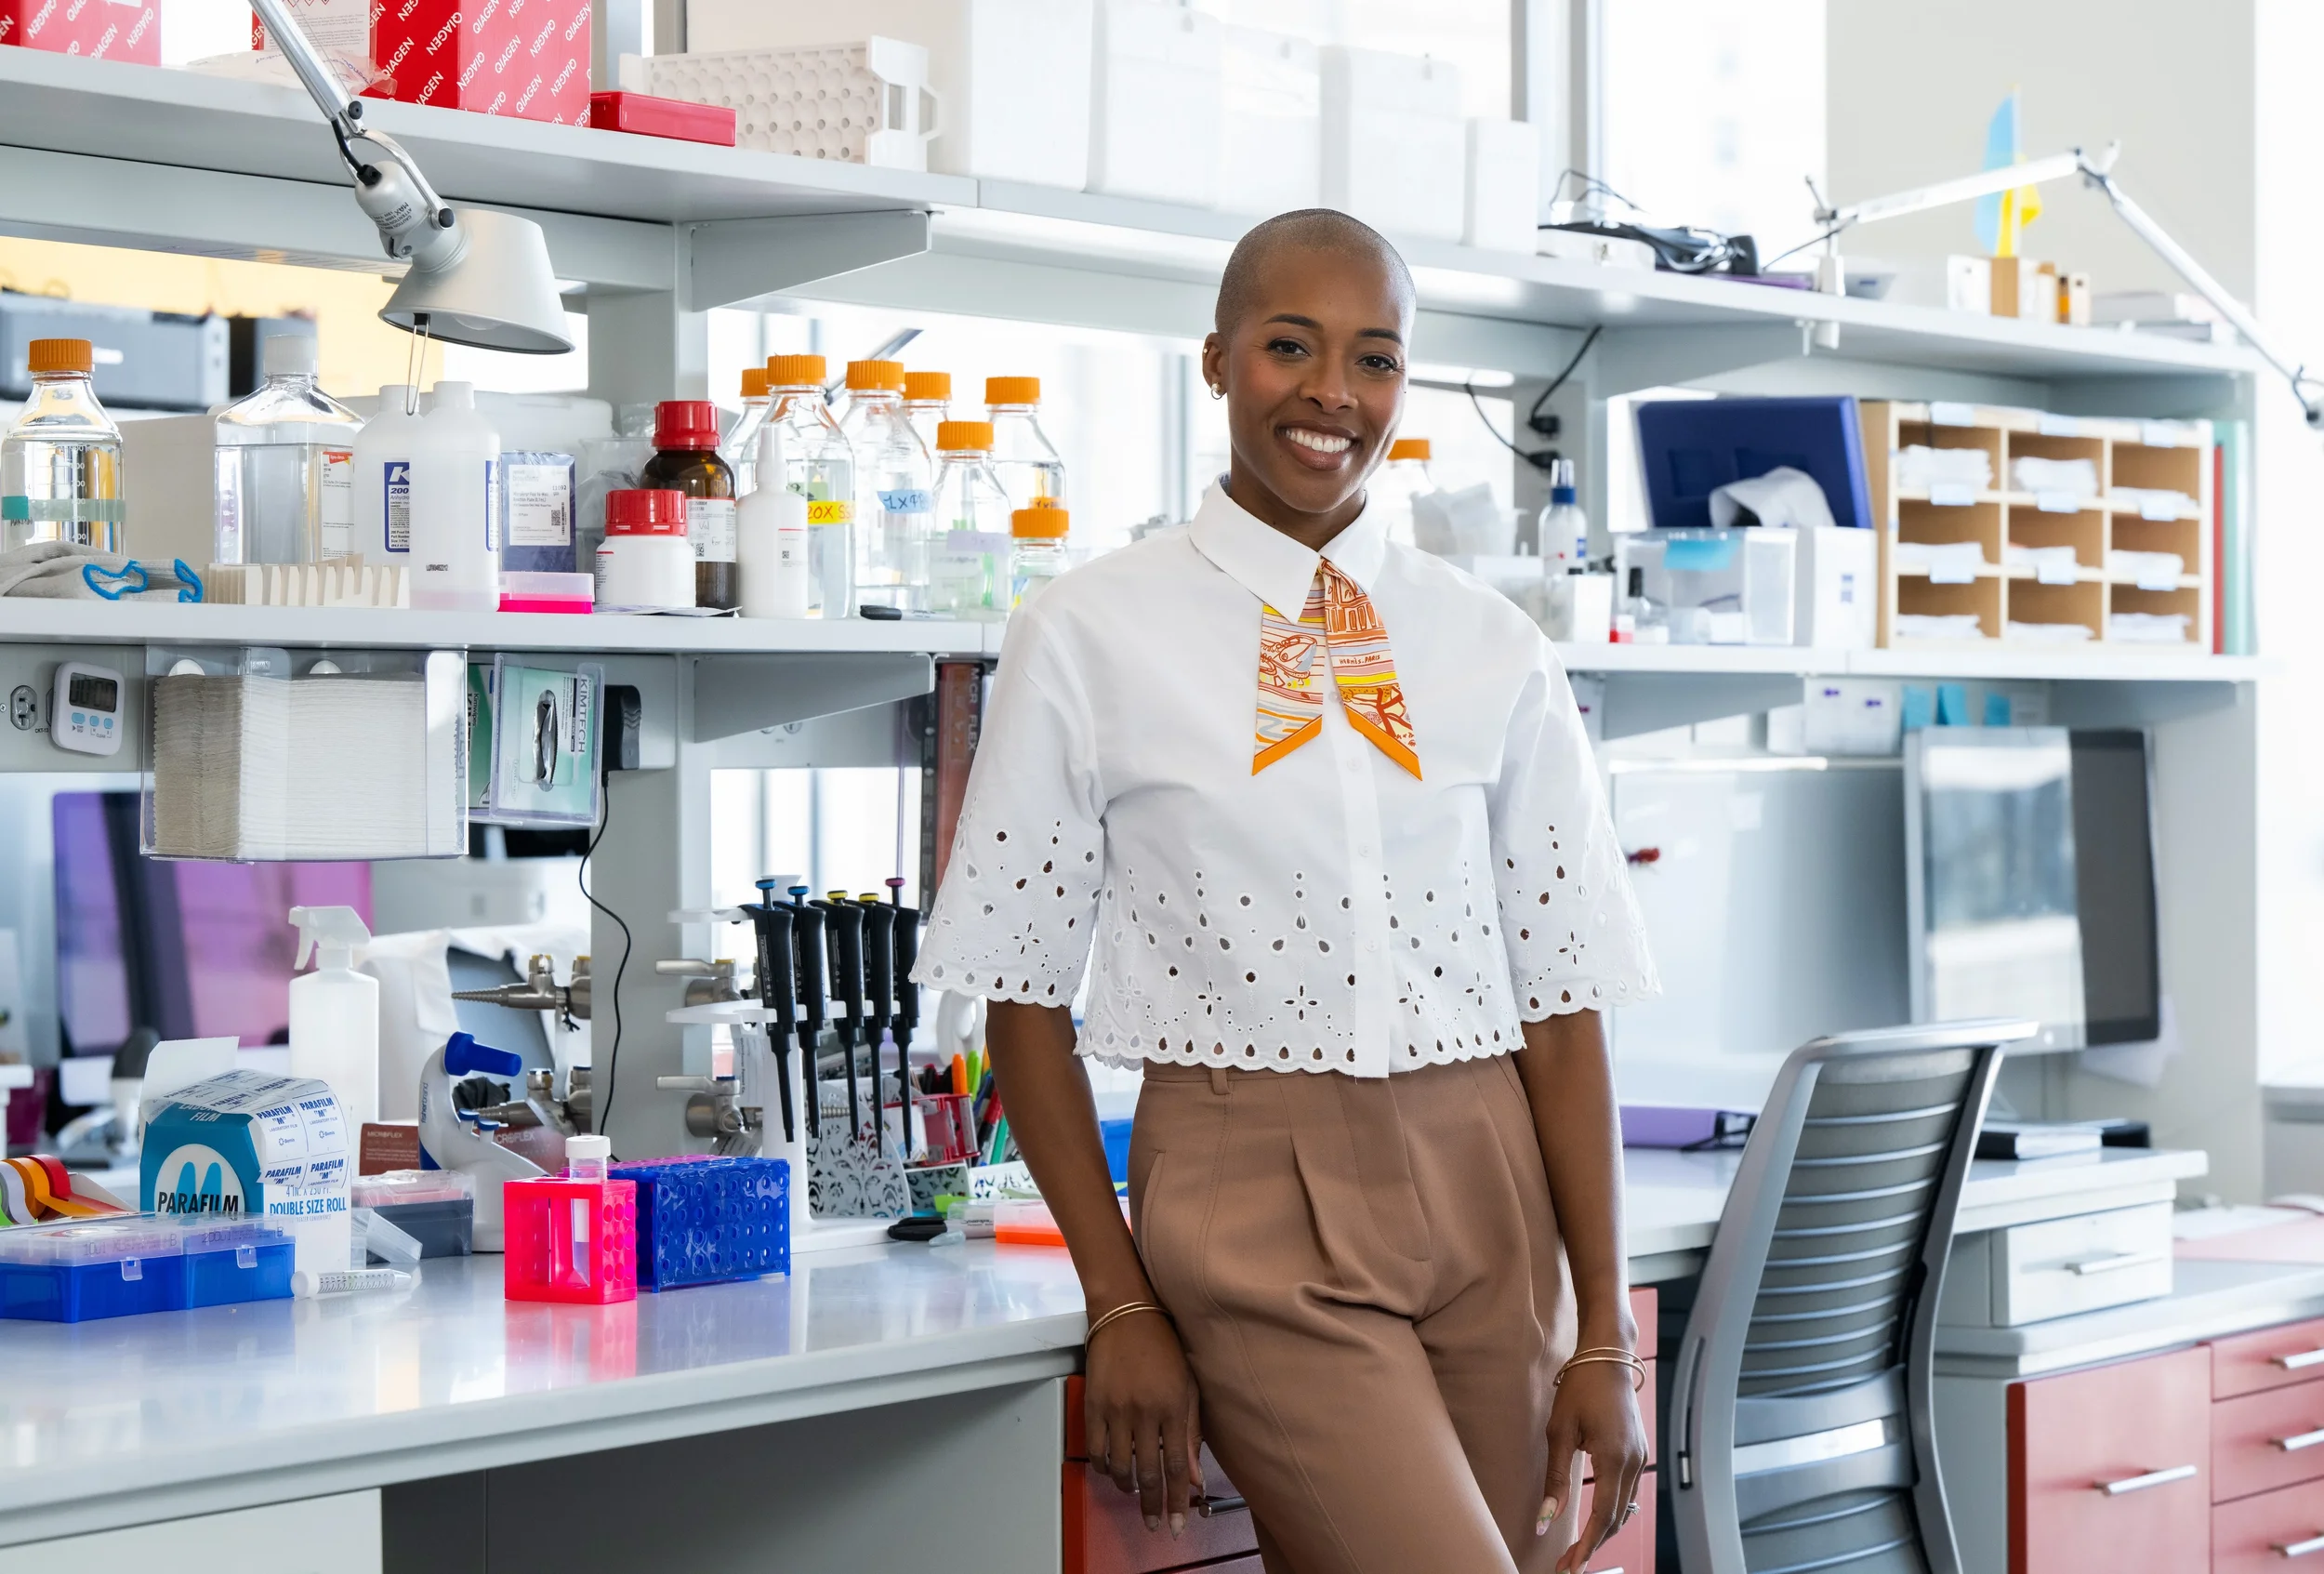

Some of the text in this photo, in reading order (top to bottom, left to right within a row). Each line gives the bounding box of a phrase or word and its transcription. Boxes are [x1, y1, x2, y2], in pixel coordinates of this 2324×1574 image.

[472, 0, 500, 33] QIAGEN
[565, 3, 591, 42] QIAGEN
[126, 7, 153, 49] QIAGEN
[426, 11, 463, 57] QIAGEN
[529, 19, 556, 59] QIAGEN
[495, 34, 522, 74] QIAGEN
[456, 51, 485, 91] QIAGEN
[550, 58, 577, 98] QIAGEN
[516, 74, 543, 113] QIAGEN
[807, 505, 834, 520] 20X
[256, 1105, 294, 1119] PARAFILM
[299, 1097, 335, 1111] PARAFILM
[190, 1112, 222, 1122] FILM
[269, 1124, 289, 1132] LABORATORY
[310, 1118, 329, 1126] LABORATORY
[265, 1165, 302, 1179] PARAFILM
[310, 1158, 344, 1173] PARAFILM
[157, 1191, 239, 1213] PARAFILM
[270, 1197, 347, 1215] DOUBLE SIZE ROLL
